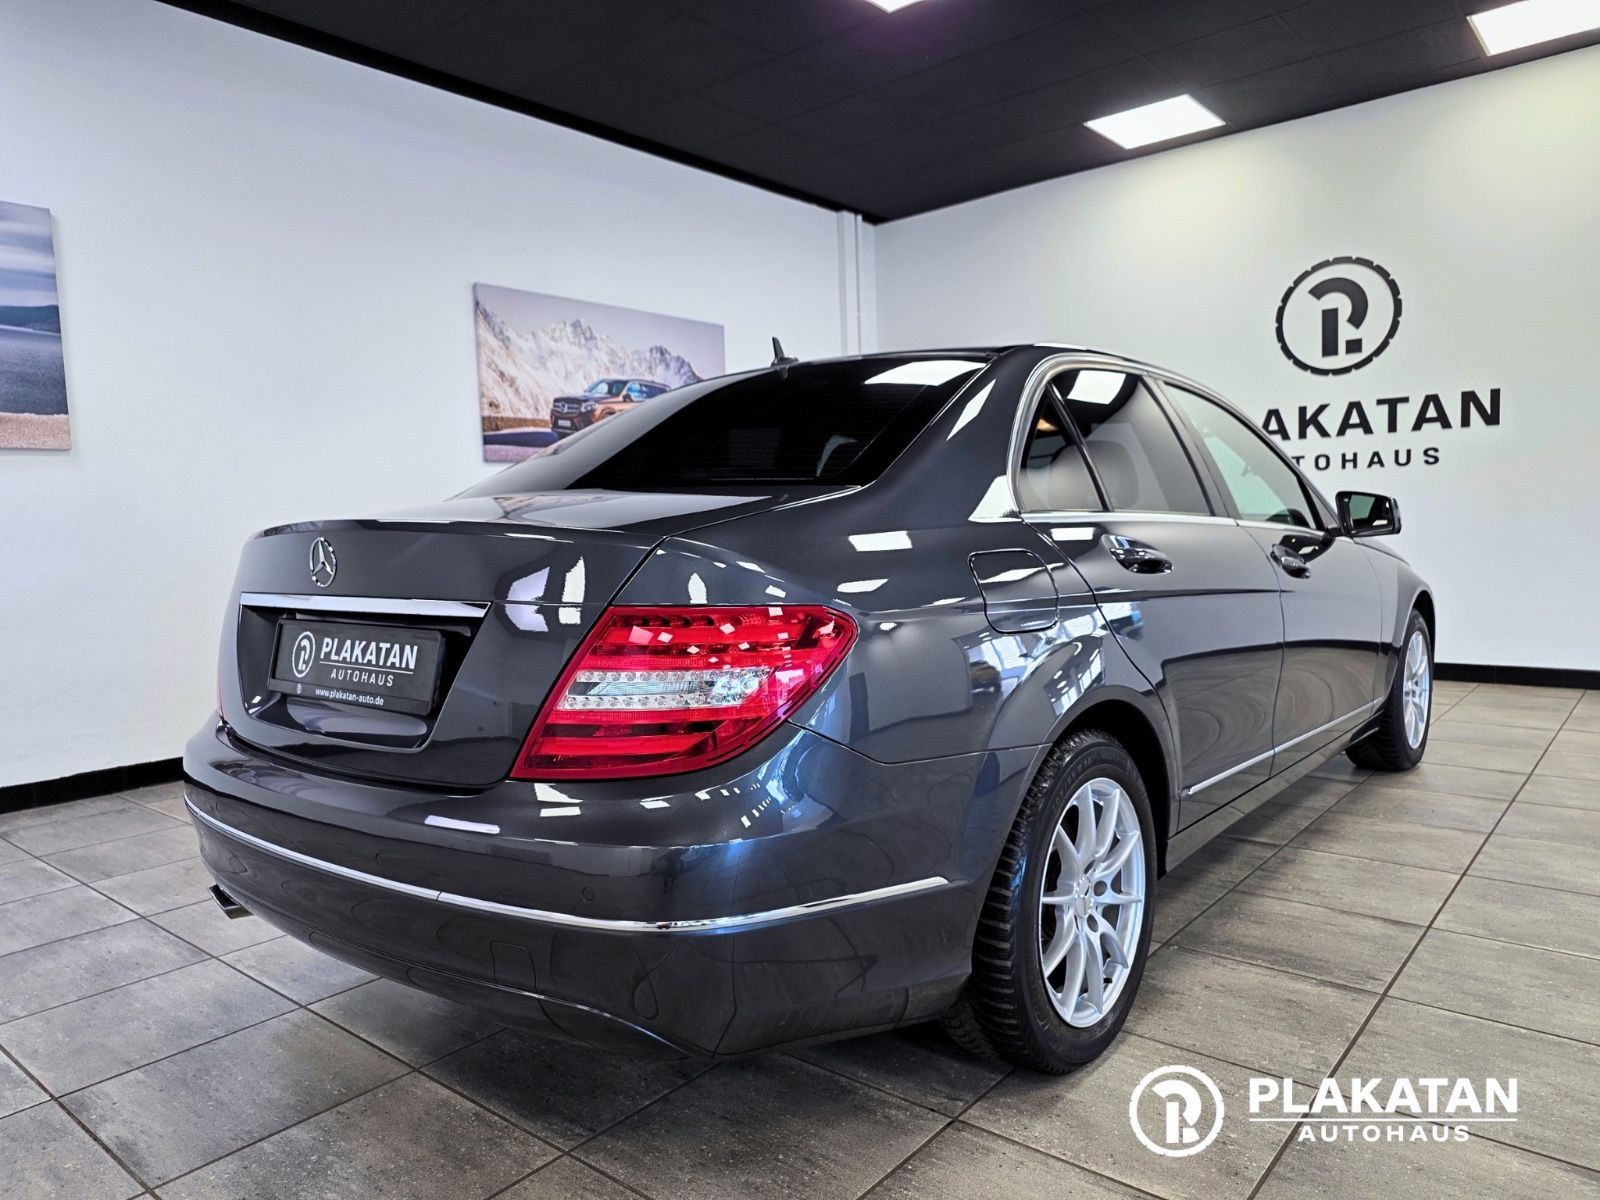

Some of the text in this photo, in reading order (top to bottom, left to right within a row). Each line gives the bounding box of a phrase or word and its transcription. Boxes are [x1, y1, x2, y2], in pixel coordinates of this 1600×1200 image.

[1261, 387, 1501, 442] AKATAN
[1290, 447, 1440, 471] TOHAUS
[320, 637, 418, 670] PLAKATAN
[330, 668, 394, 687] AUTOHAUS
[315, 687, 384, 706] www.plakatan-auto.de
